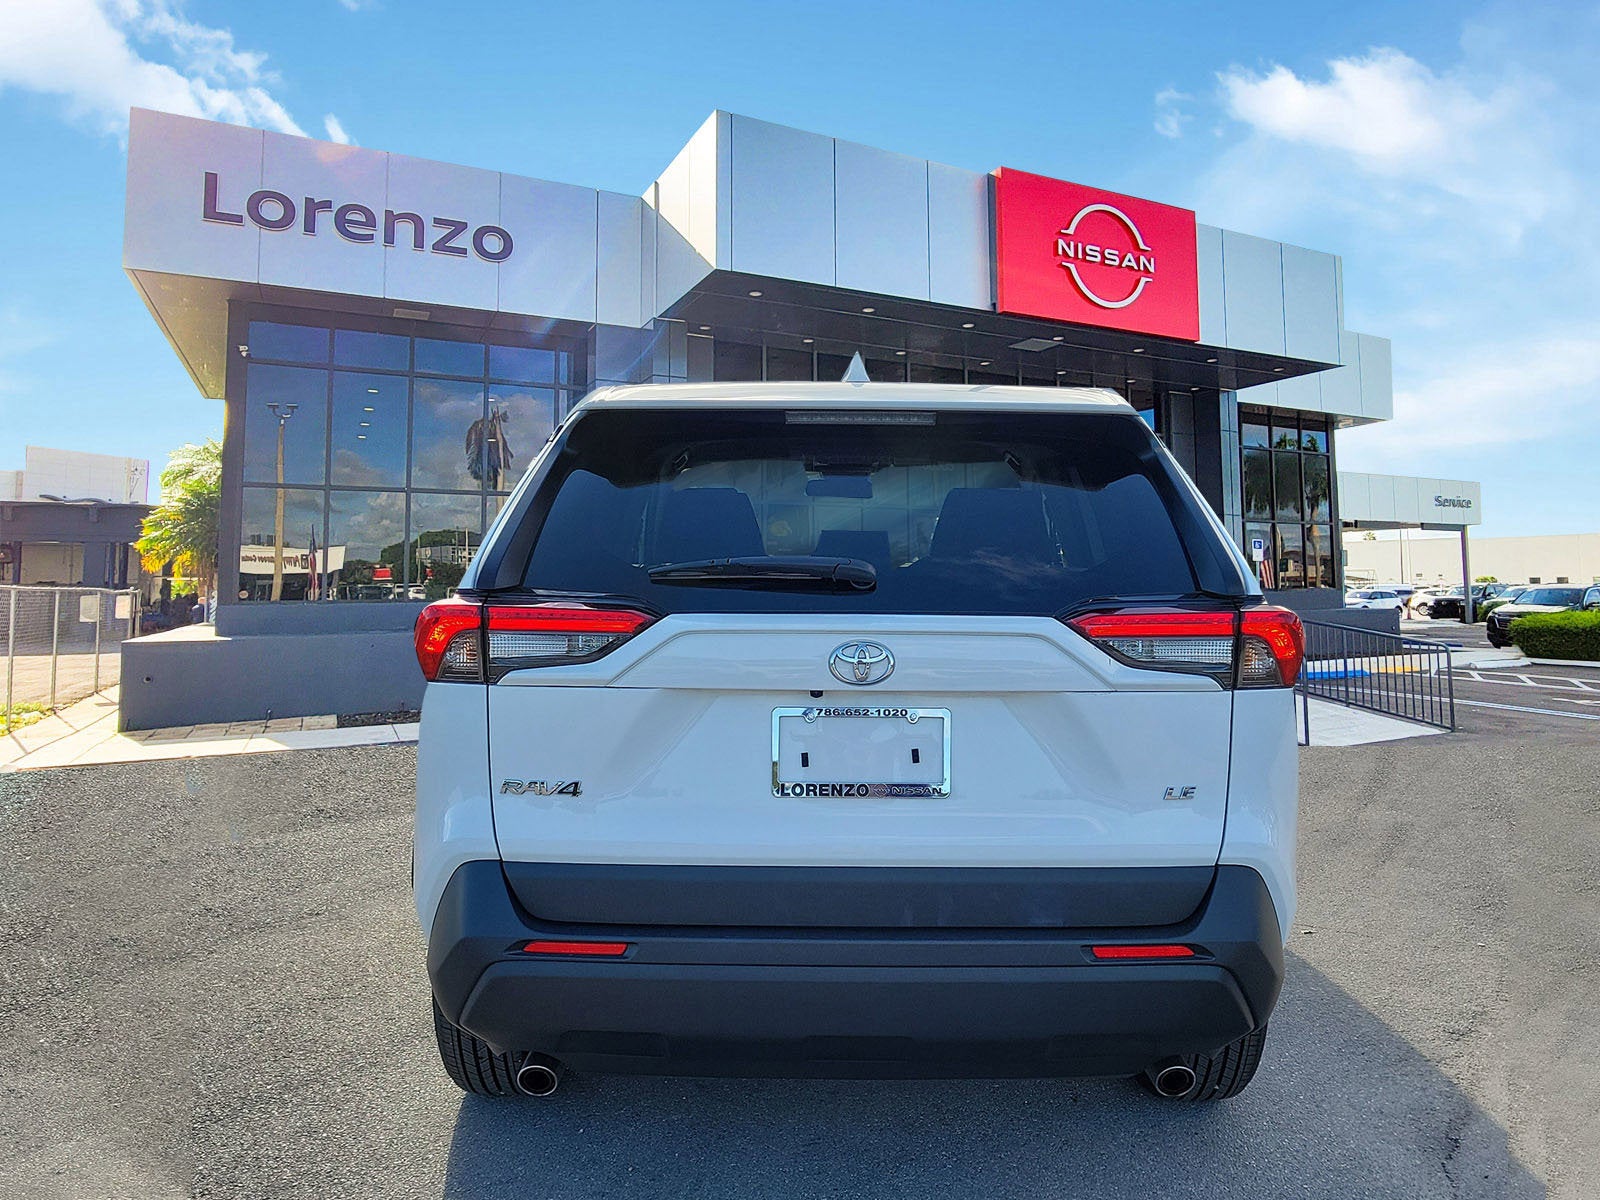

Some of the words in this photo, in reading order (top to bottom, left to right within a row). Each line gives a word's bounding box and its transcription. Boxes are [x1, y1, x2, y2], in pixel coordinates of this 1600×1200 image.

[203, 171, 514, 262] Lorenzo
[1057, 238, 1155, 273] NISSAN
[1434, 495, 1472, 508] Service
[815, 708, 908, 717] 786-652-1020
[500, 779, 583, 798] RAV4
[780, 783, 870, 797] LORENZO
[891, 786, 943, 796] NISSAN
[1163, 786, 1196, 800] LE
